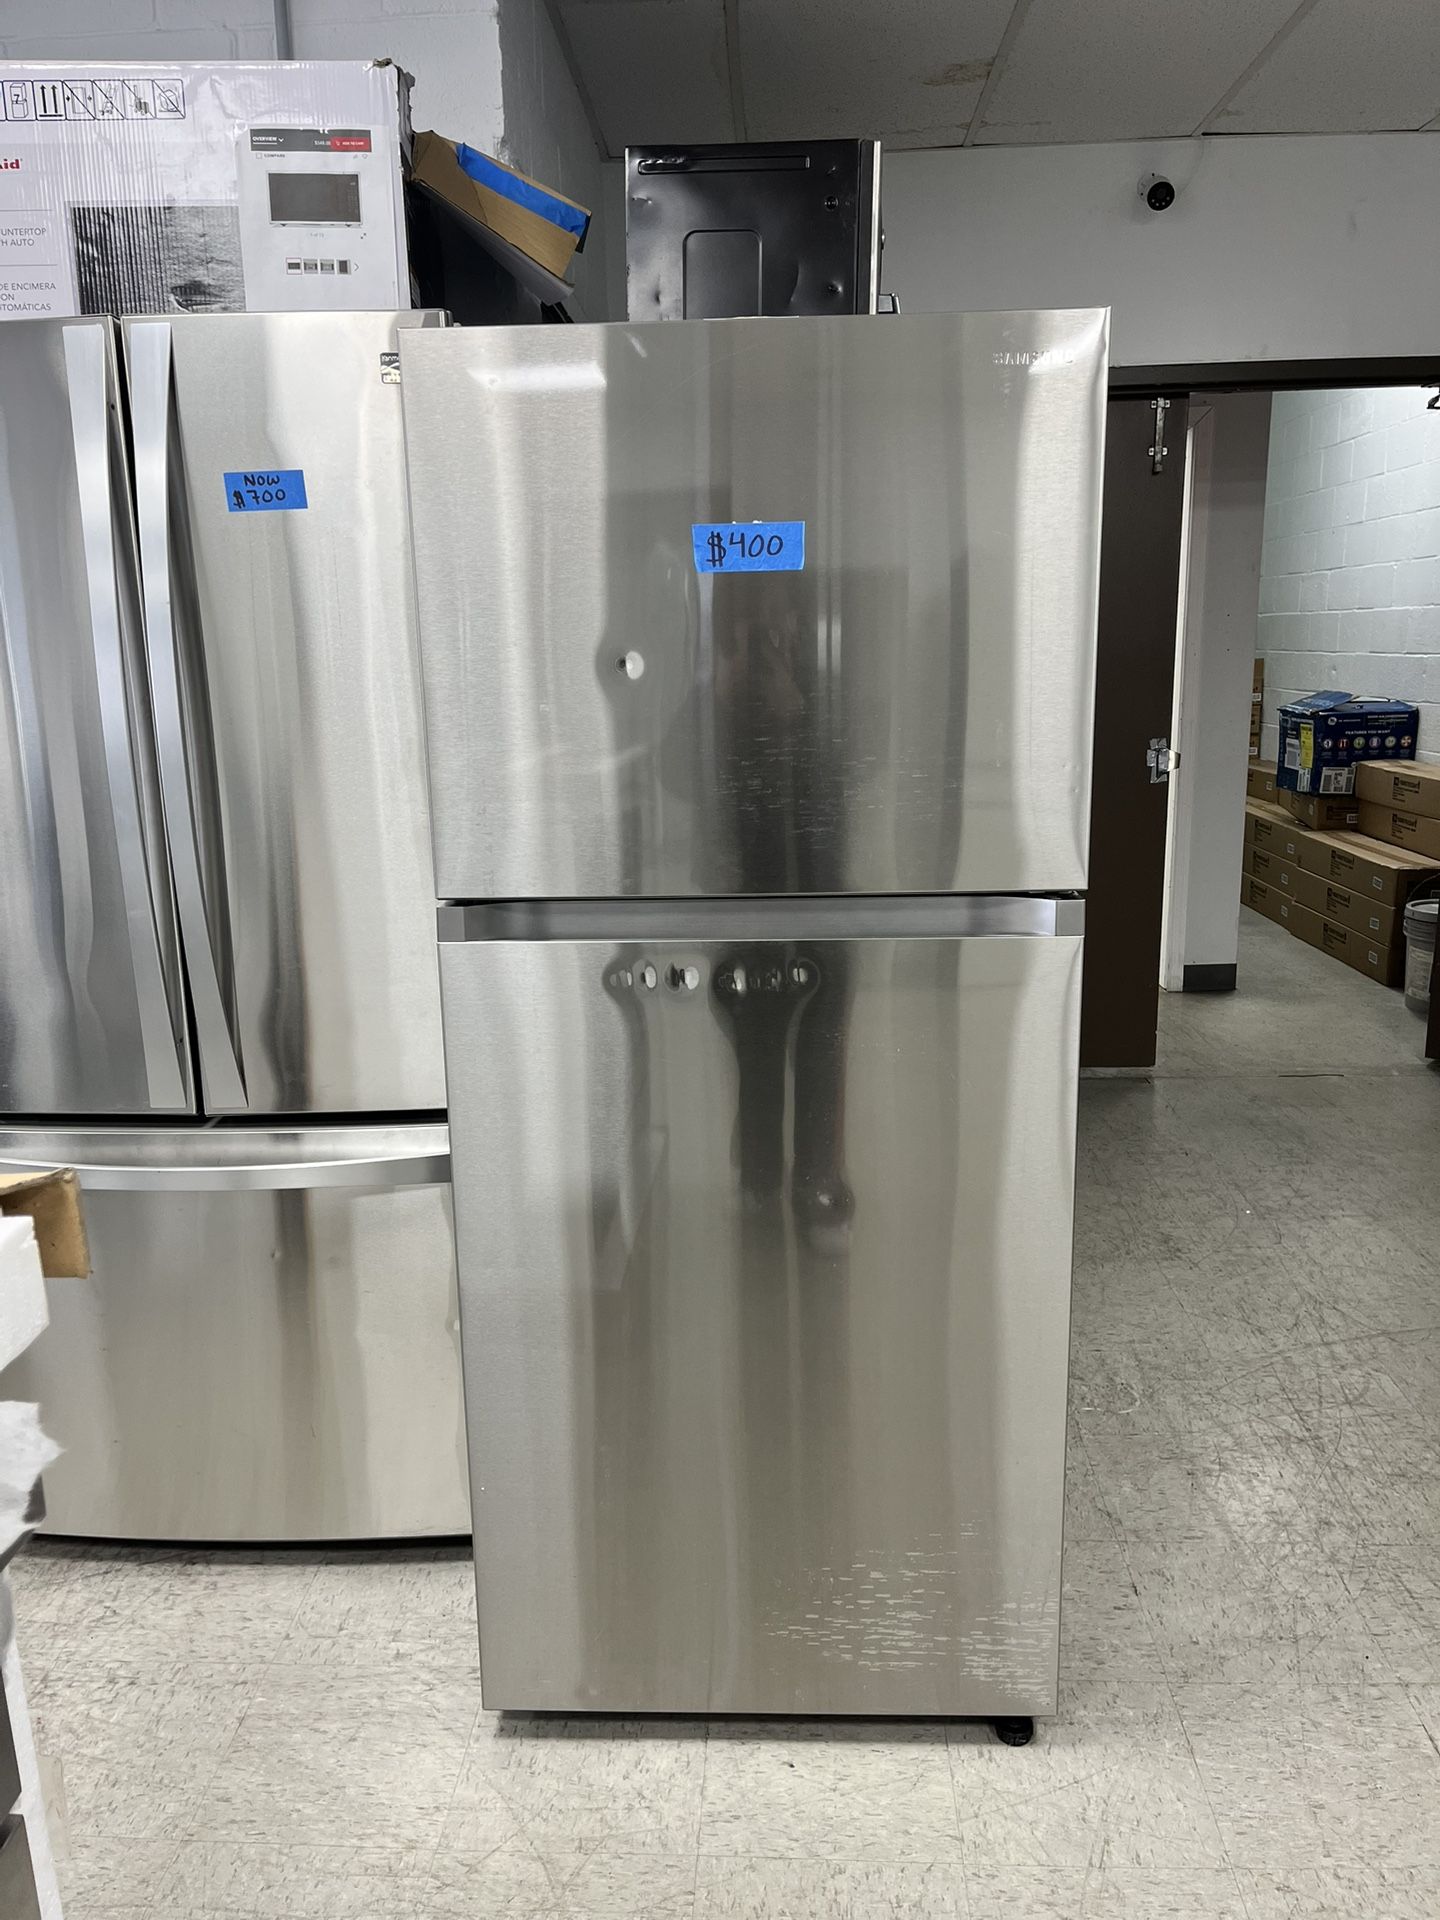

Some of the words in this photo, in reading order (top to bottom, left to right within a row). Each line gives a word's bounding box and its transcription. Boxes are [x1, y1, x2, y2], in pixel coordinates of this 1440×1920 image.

[10, 238, 35, 246] AUTO
[11, 282, 56, 291] ENCIMERA
[233, 489, 286, 509] $700
[706, 530, 784, 568] $400
